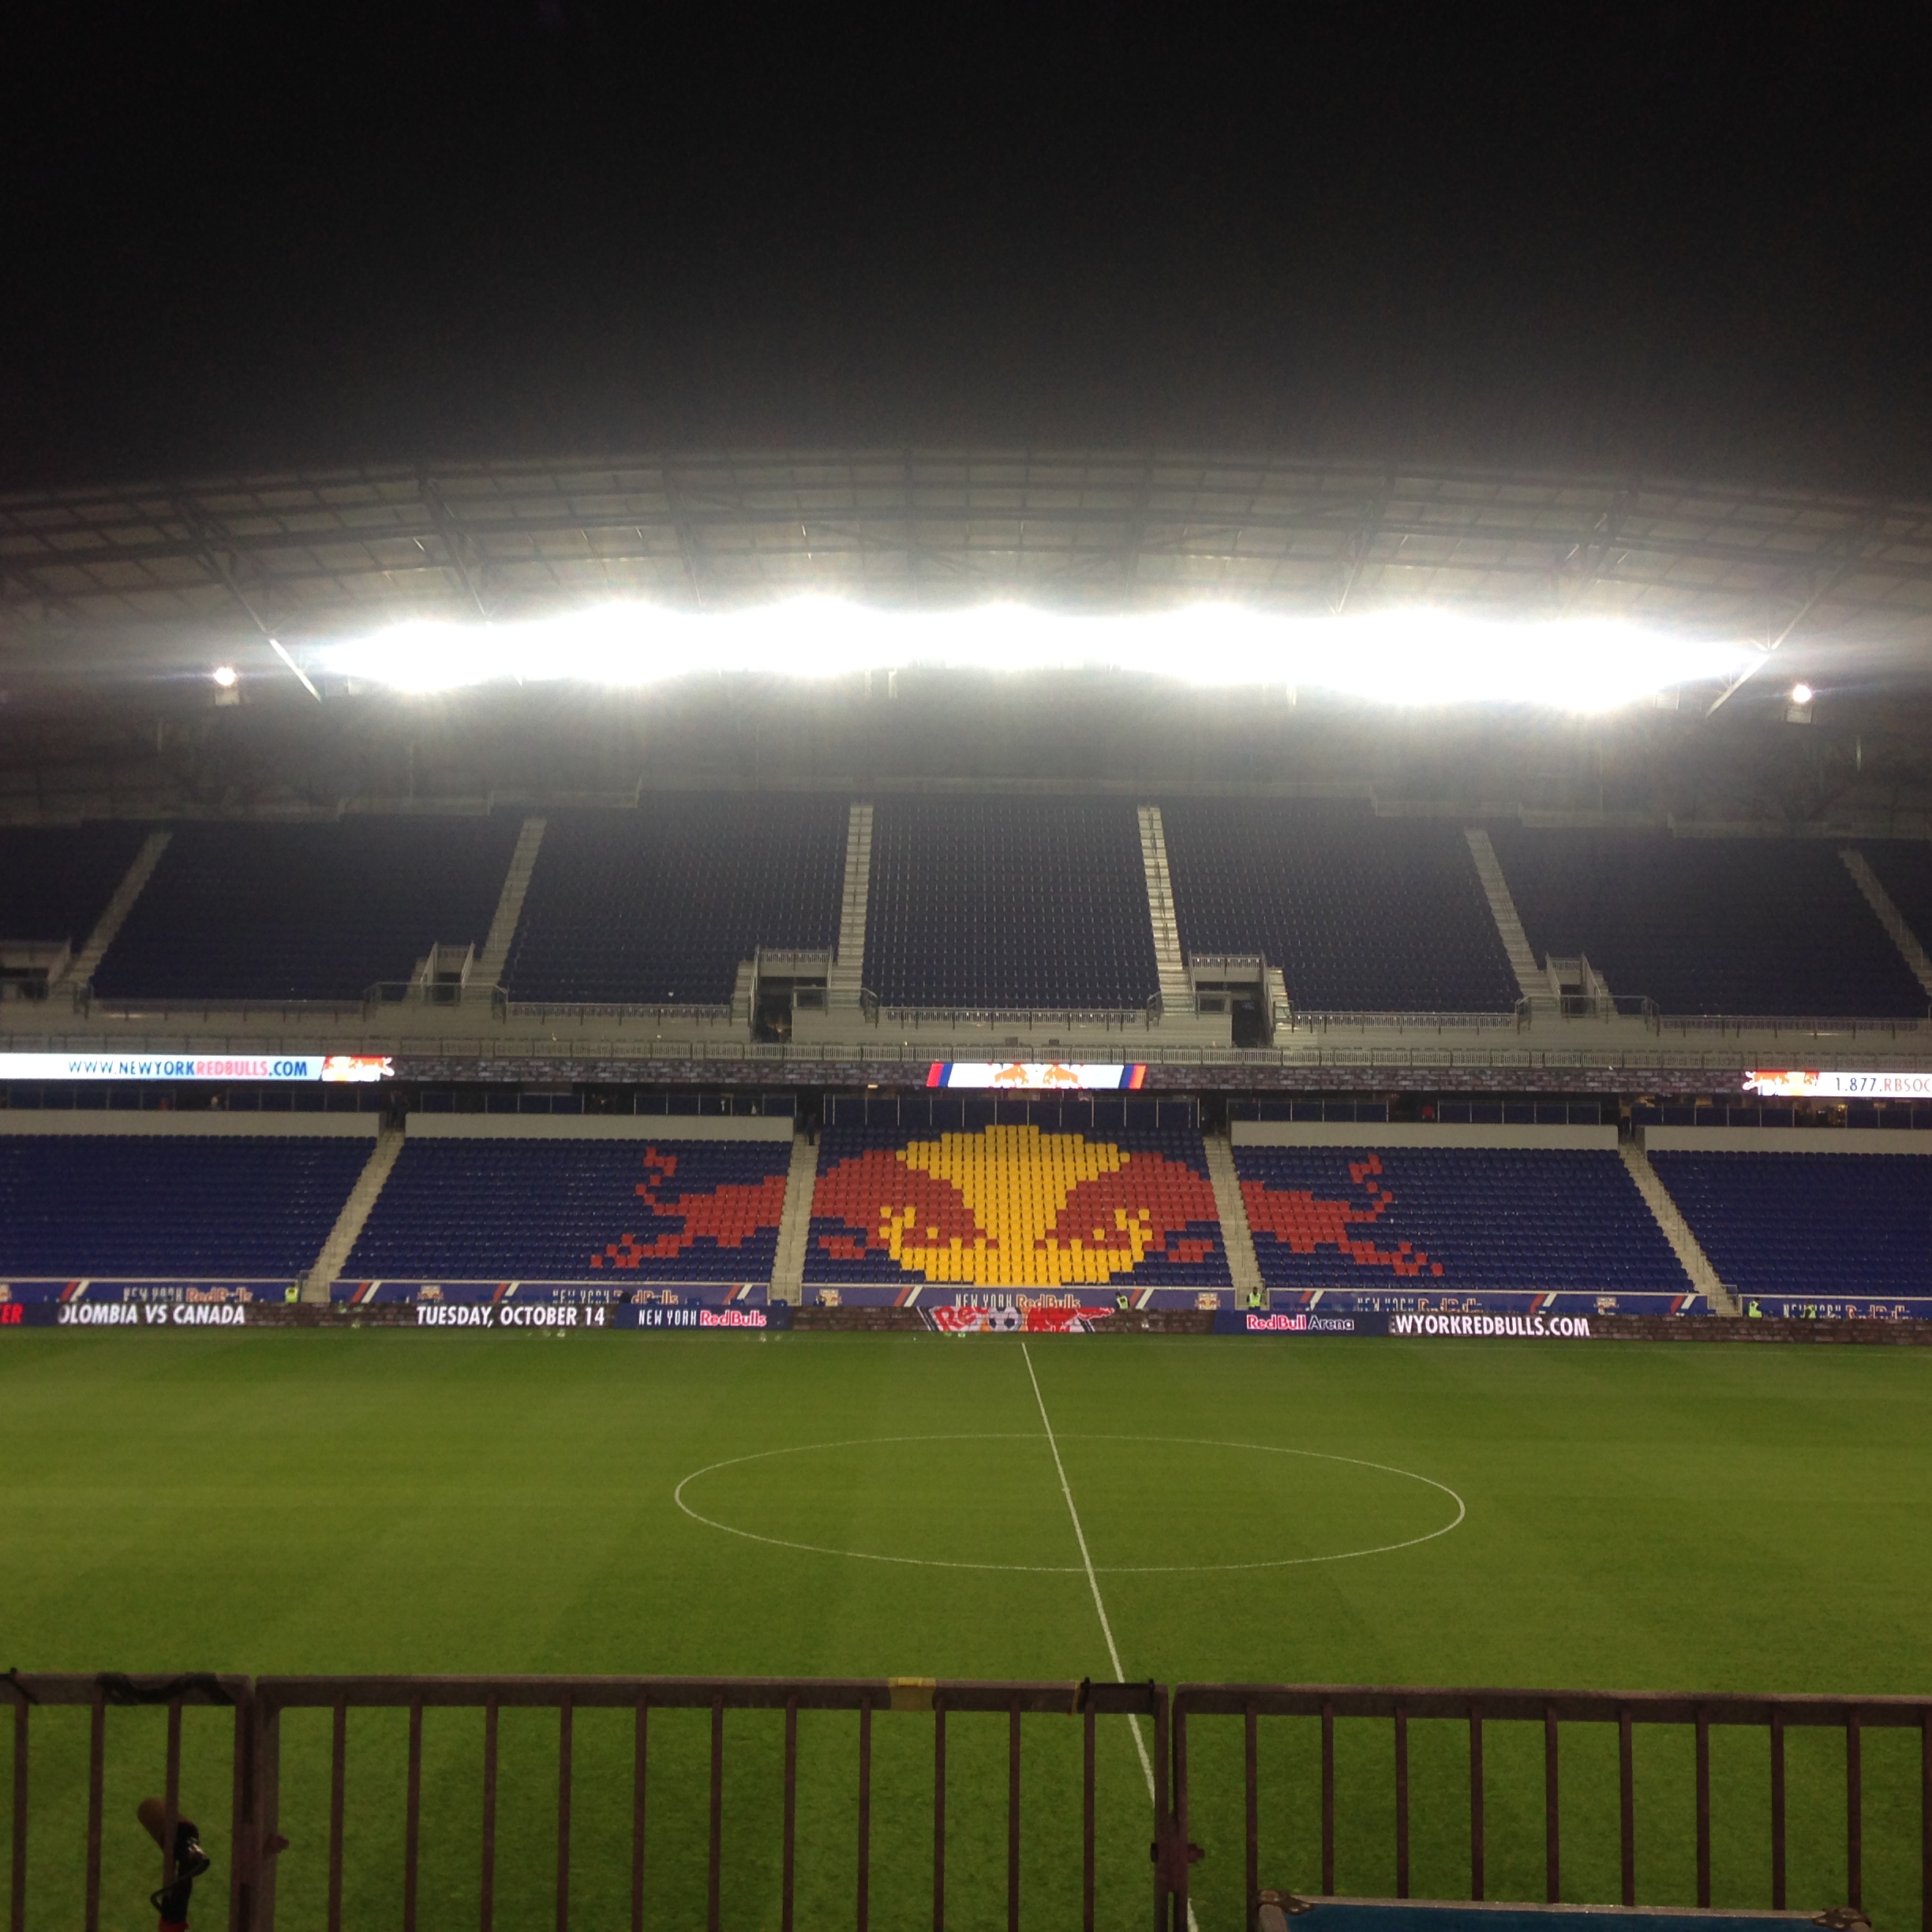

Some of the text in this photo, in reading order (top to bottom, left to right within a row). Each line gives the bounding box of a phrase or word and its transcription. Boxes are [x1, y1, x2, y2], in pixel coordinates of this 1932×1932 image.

[68, 1060, 308, 1076] WWW.NEWYORKREDBULLS.COM
[186, 1286, 253, 1302] RedBlls
[613, 1289, 679, 1305] RdBlls
[955, 1294, 978, 1308] NEW
[983, 1294, 1012, 1308] YORK
[145, 1305, 167, 1324] VS
[173, 1305, 245, 1324] CANADA
[417, 1306, 605, 1327] TUESDAY, OCTOBER 14
[638, 1309, 662, 1325] NEW
[667, 1310, 697, 1327] YORK
[1308, 1316, 1355, 1331] Arena
